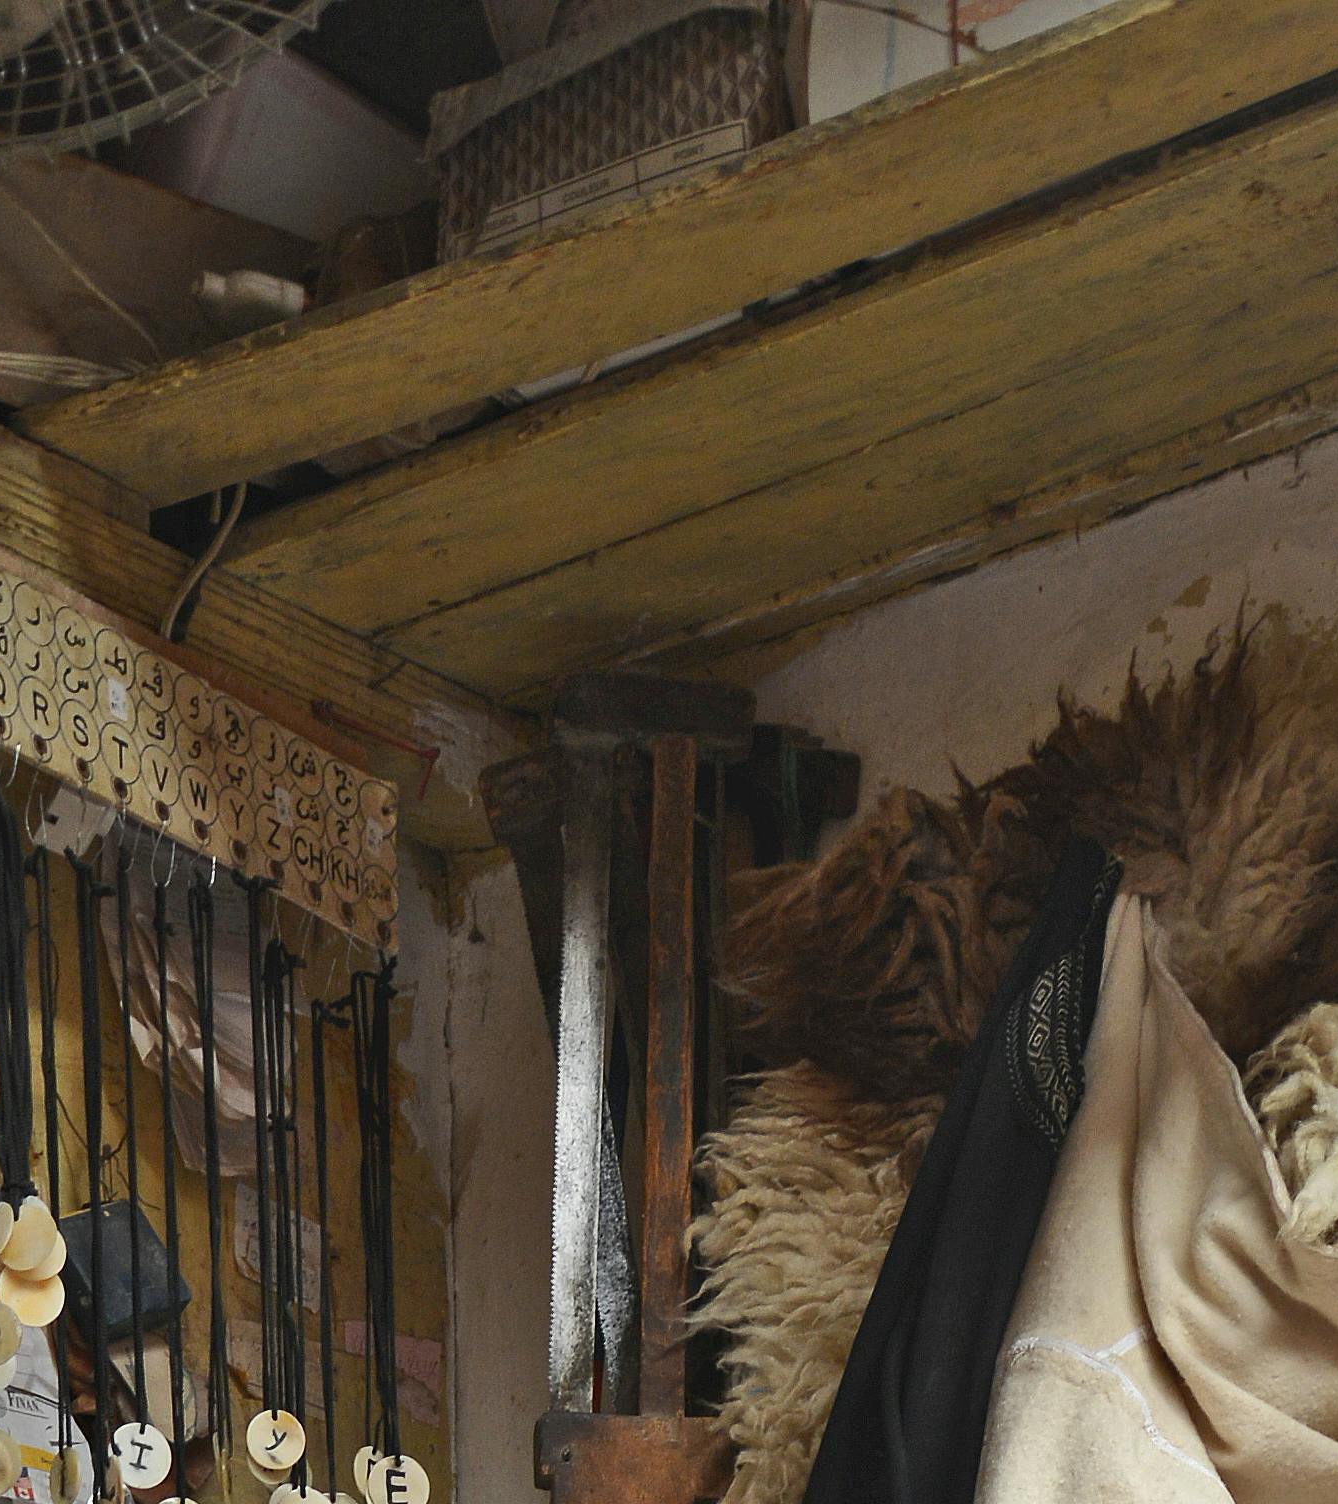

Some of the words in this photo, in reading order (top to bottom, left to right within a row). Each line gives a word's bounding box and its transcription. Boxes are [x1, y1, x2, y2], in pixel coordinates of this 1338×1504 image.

[32, 690, 50, 726] R
[72, 714, 90, 747] S
[111, 735, 129, 770] T
[152, 759, 169, 793] V
[189, 777, 208, 812] W
[229, 798, 244, 830] Y
[267, 816, 282, 850] Z
[293, 836, 324, 875] CH
[331, 856, 359, 895] KH
